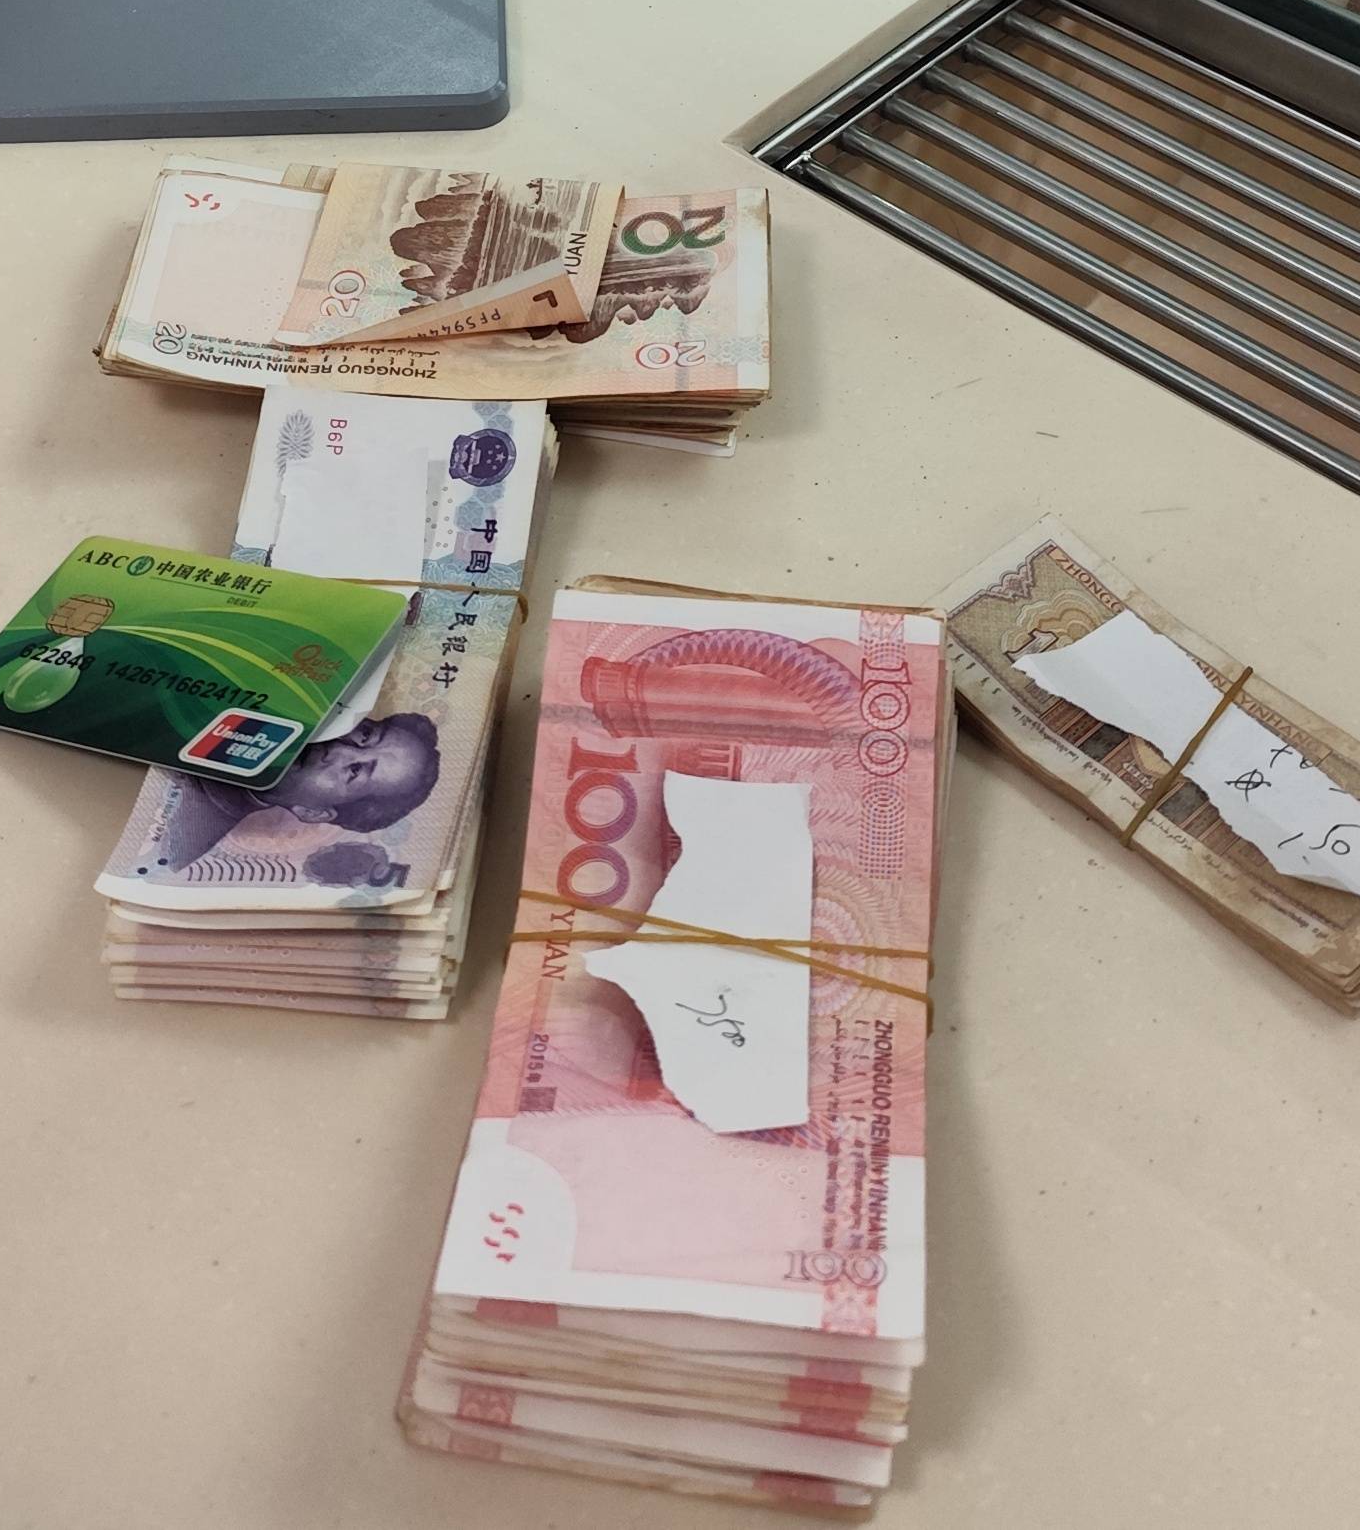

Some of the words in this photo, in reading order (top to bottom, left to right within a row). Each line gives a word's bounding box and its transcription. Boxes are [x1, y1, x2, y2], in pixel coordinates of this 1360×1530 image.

[620, 206, 730, 255] 20
[320, 269, 368, 320] 20
[151, 321, 189, 356] 20
[185, 348, 266, 372] YINHANG
[635, 339, 709, 370] 20
[264, 356, 334, 377] RENMIN
[333, 361, 438, 380] ZHONGGUO
[76, 548, 129, 571] ABC
[154, 560, 274, 596] 中国农业银行
[430, 516, 500, 690] 中国人民银行
[18, 643, 97, 672] 622848
[104, 659, 270, 712] 1426716624172
[211, 721, 278, 753] UnionPay
[857, 656, 913, 777] 100
[555, 735, 639, 910] 100
[540, 907, 577, 983] YUAN
[870, 1019, 895, 1111] ZHONGGUO
[869, 1109, 893, 1172] RENMIN
[783, 1249, 888, 1288] 100
